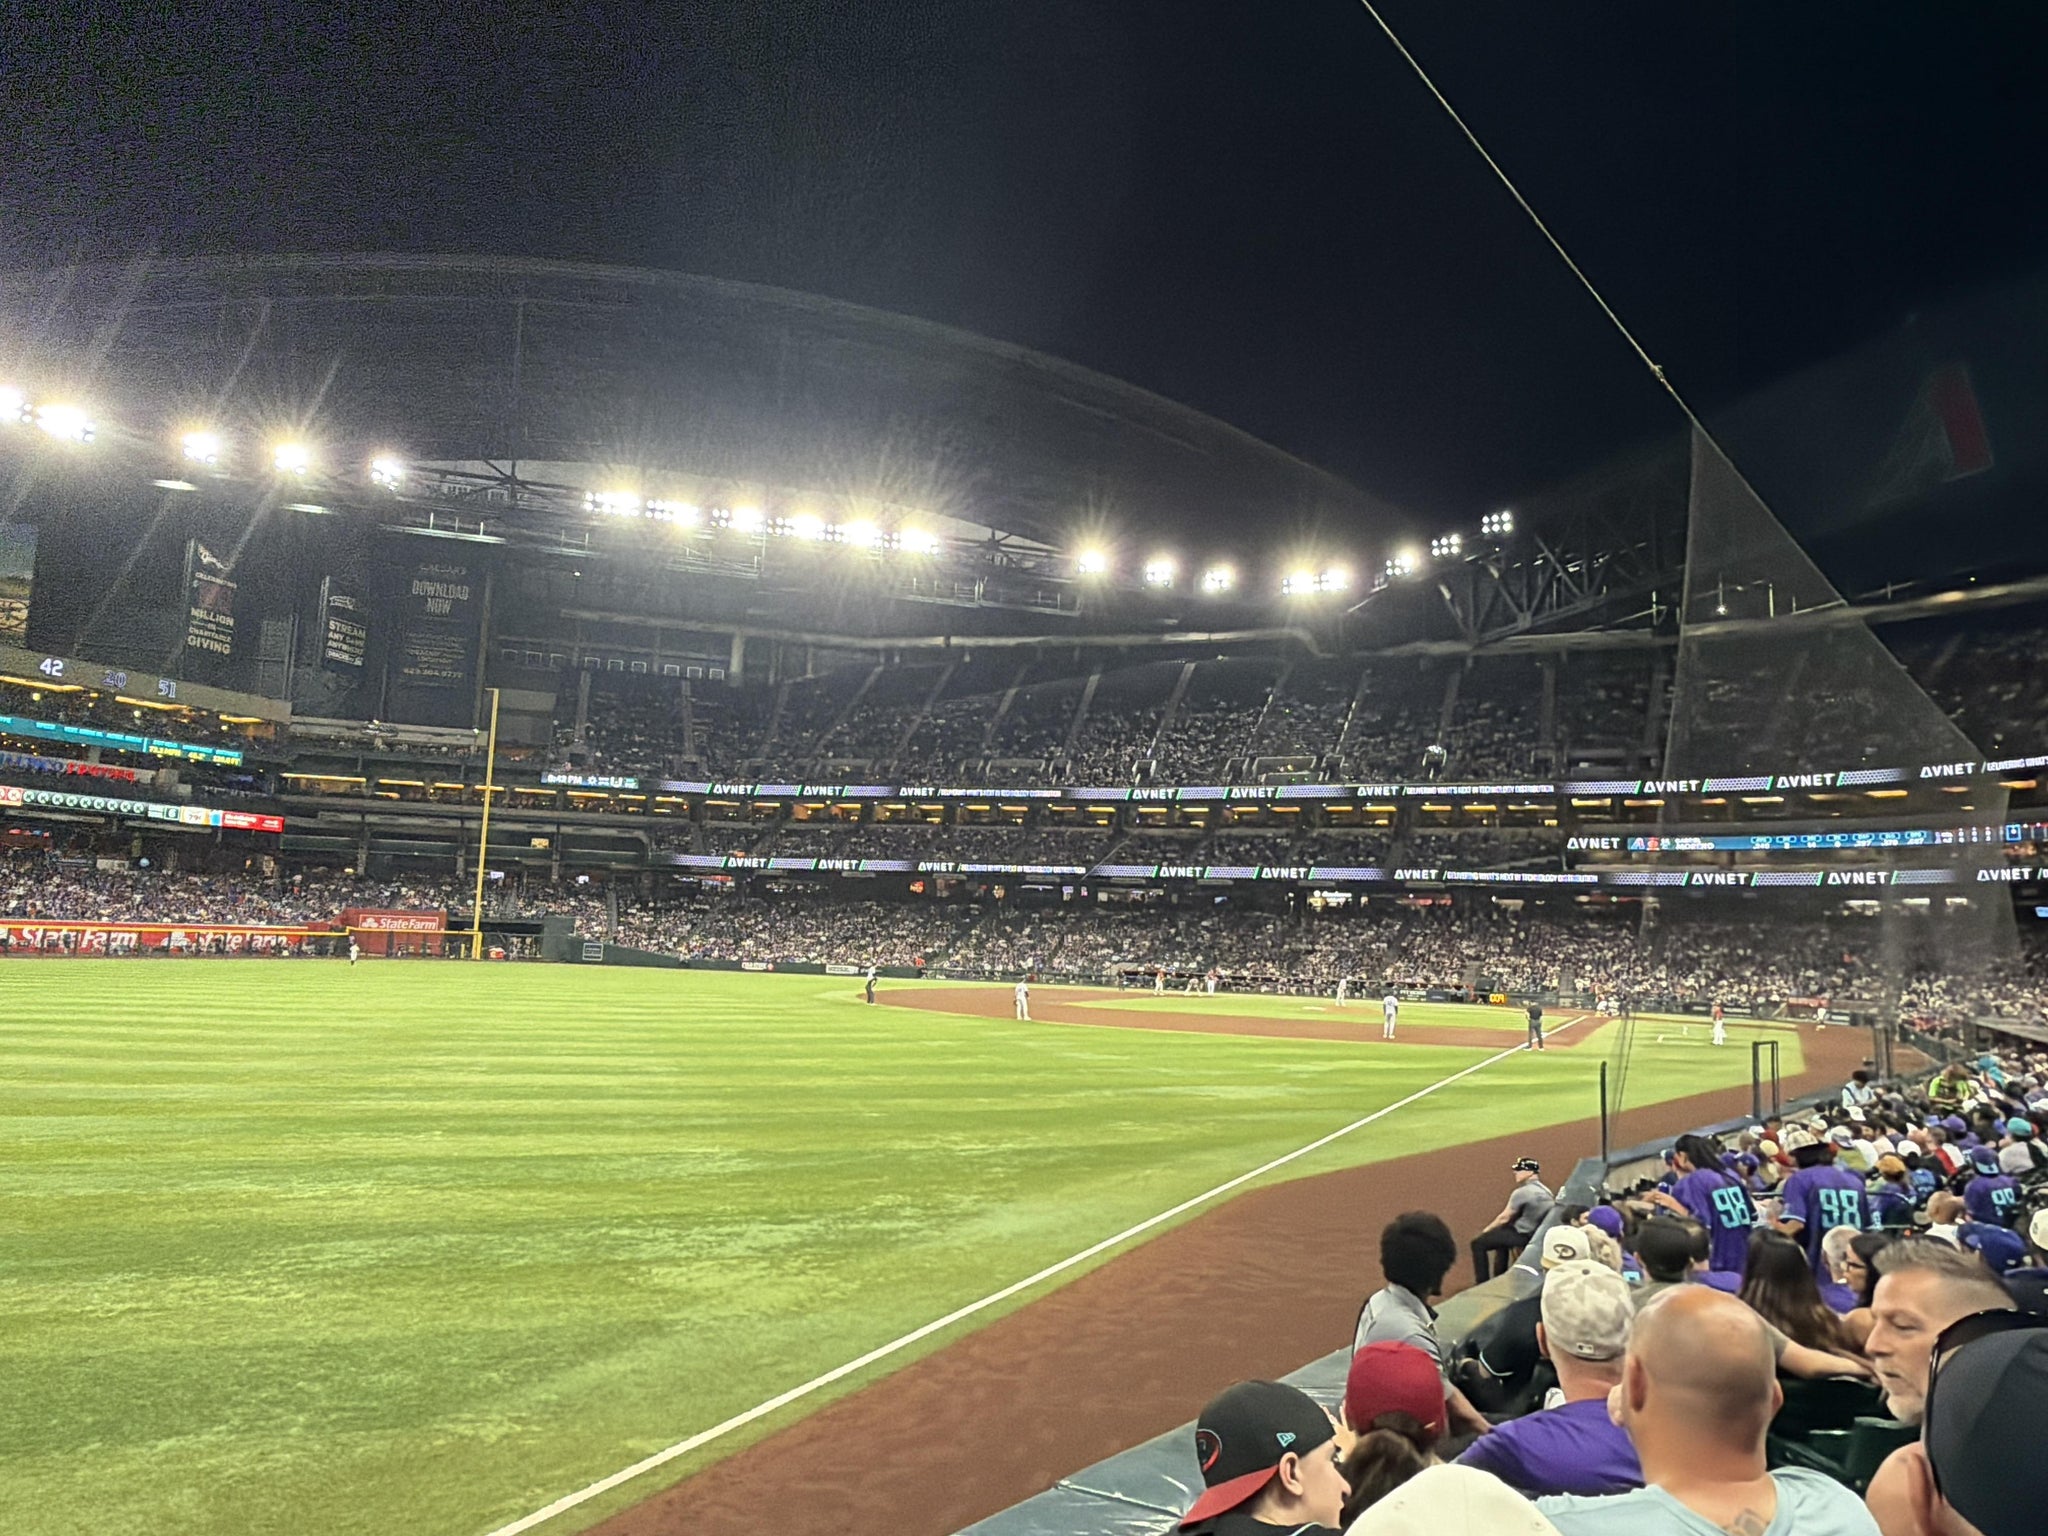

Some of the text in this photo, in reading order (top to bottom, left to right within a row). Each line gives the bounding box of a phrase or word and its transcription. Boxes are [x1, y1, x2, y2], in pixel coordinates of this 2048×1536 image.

[412, 580, 469, 600] DOWNLOAD
[191, 607, 234, 627] MILLION
[328, 620, 366, 638] STREAM
[187, 634, 231, 655] GIVING
[39, 657, 64, 677] 42
[102, 670, 127, 689] 20
[158, 679, 177, 698] 51
[1920, 762, 1977, 779] AVNET
[1643, 780, 1700, 793] AVNET
[1776, 773, 1836, 789] AVNET
[713, 784, 754, 795] AVNET
[803, 785, 843, 796] AVNET
[900, 786, 936, 797] AVNET
[1132, 789, 1176, 800] AVNET
[1230, 787, 1275, 798] AVNET
[1357, 786, 1399, 796] AVNET
[1567, 837, 1620, 849] AVNET
[728, 857, 768, 868] AVNET
[818, 859, 859, 871] AVNET
[918, 861, 955, 872] AVNET
[1159, 866, 1203, 877] AVNET
[1261, 867, 1308, 879] AVNET
[1394, 868, 1439, 880] AVNET
[1827, 871, 1889, 885] AVNET
[1977, 867, 2033, 881] AVNET
[1691, 872, 1749, 885] AVNET
[1712, 1185, 1750, 1229] 98
[1819, 1188, 1862, 1230] 98
